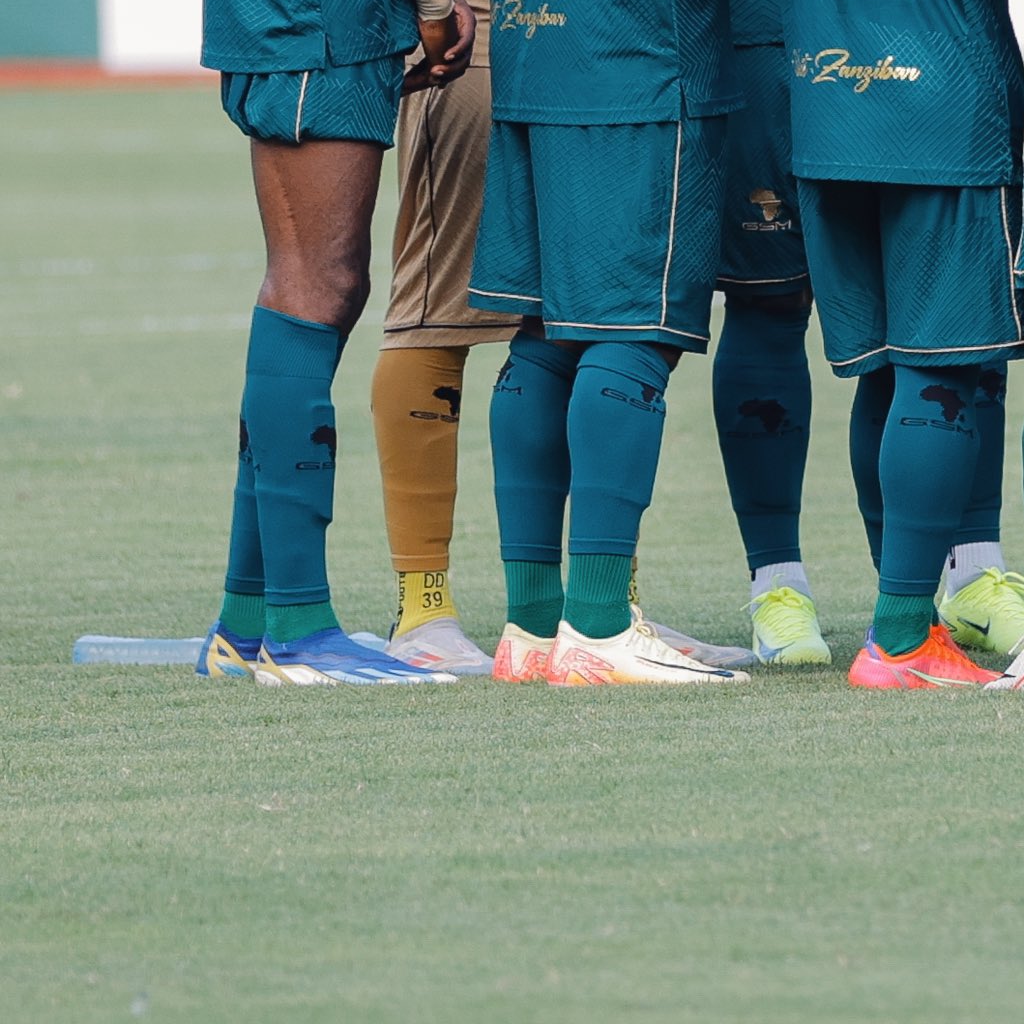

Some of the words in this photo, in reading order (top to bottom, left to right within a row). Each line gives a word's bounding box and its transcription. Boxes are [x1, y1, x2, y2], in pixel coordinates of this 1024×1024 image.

[812, 49, 920, 93] Zanzibar
[742, 220, 791, 231] GSM
[901, 417, 974, 439] GSM
[424, 572, 444, 589] DD
[422, 591, 443, 609] 39
